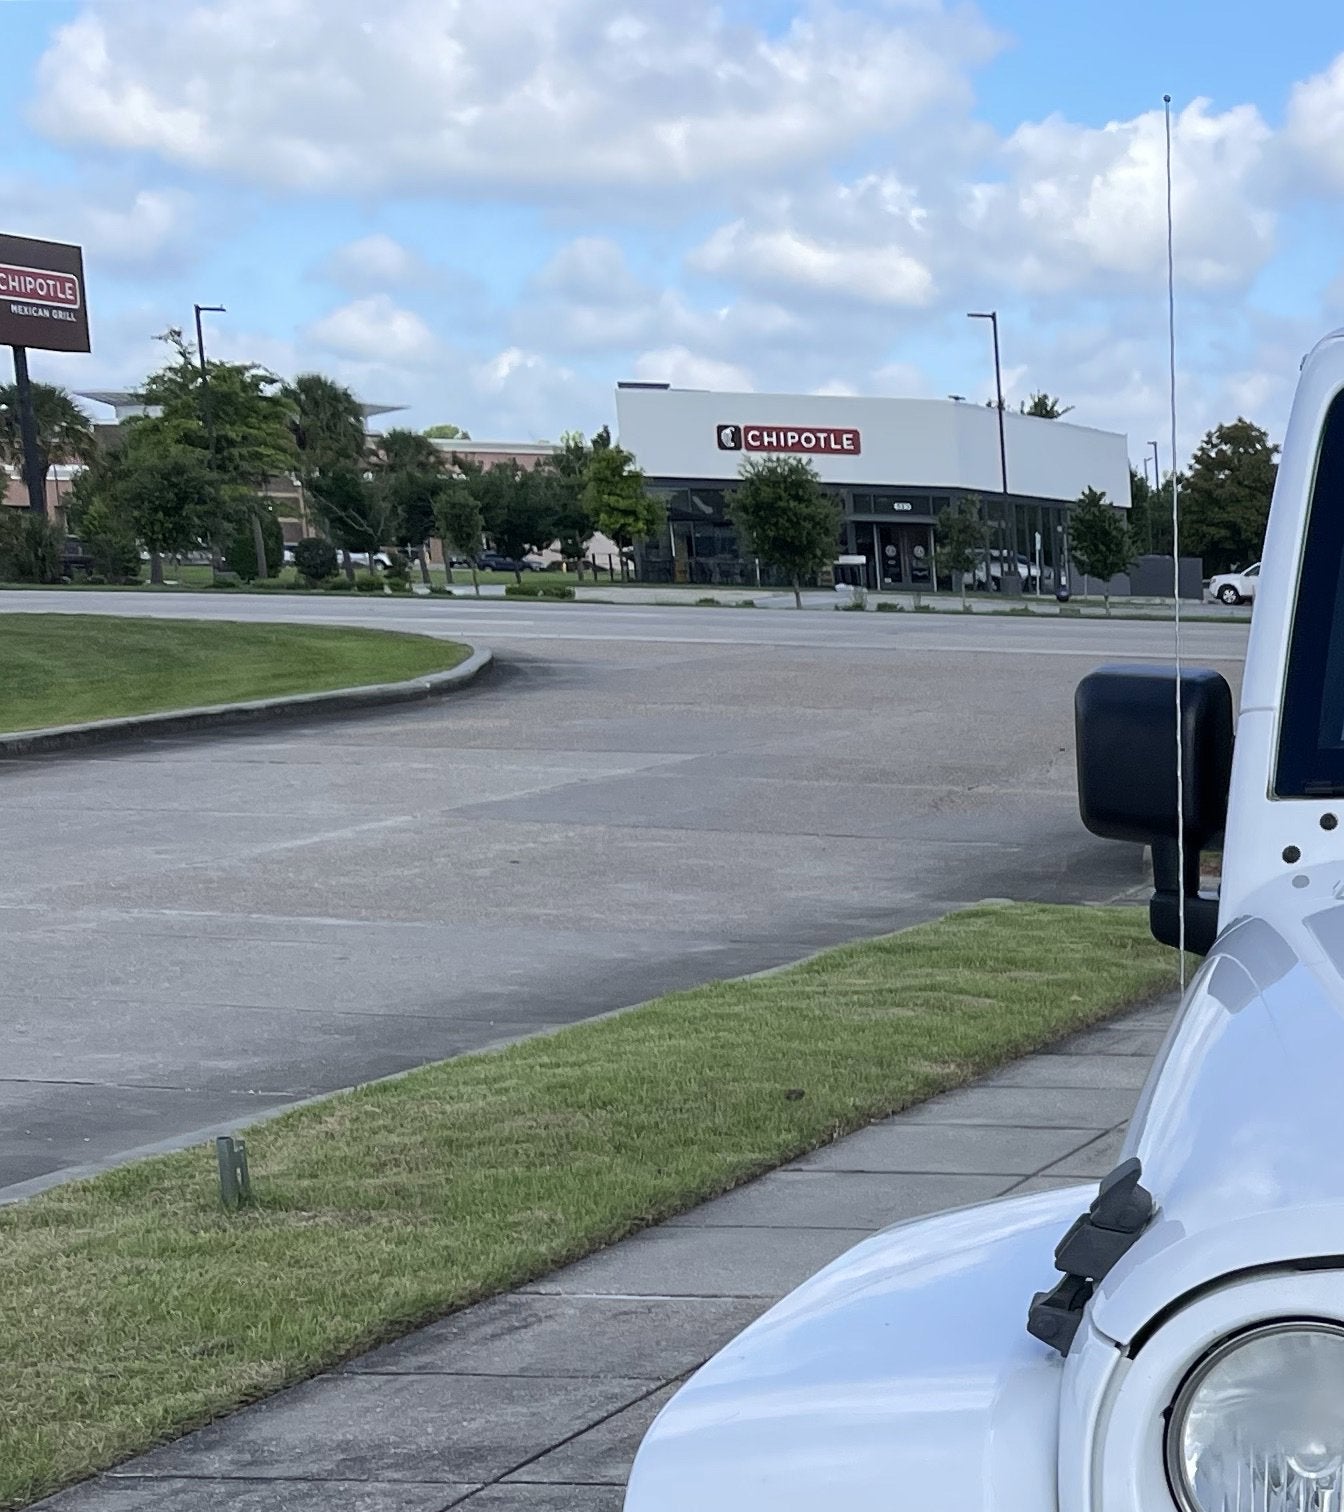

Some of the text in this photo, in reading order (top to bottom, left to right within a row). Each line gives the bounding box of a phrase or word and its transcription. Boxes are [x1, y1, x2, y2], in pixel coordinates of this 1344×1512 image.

[0, 272, 76, 300] CHIPOTLE
[10, 303, 77, 321] MEXICAN GRILL
[747, 430, 855, 450] CHIPOTLE
